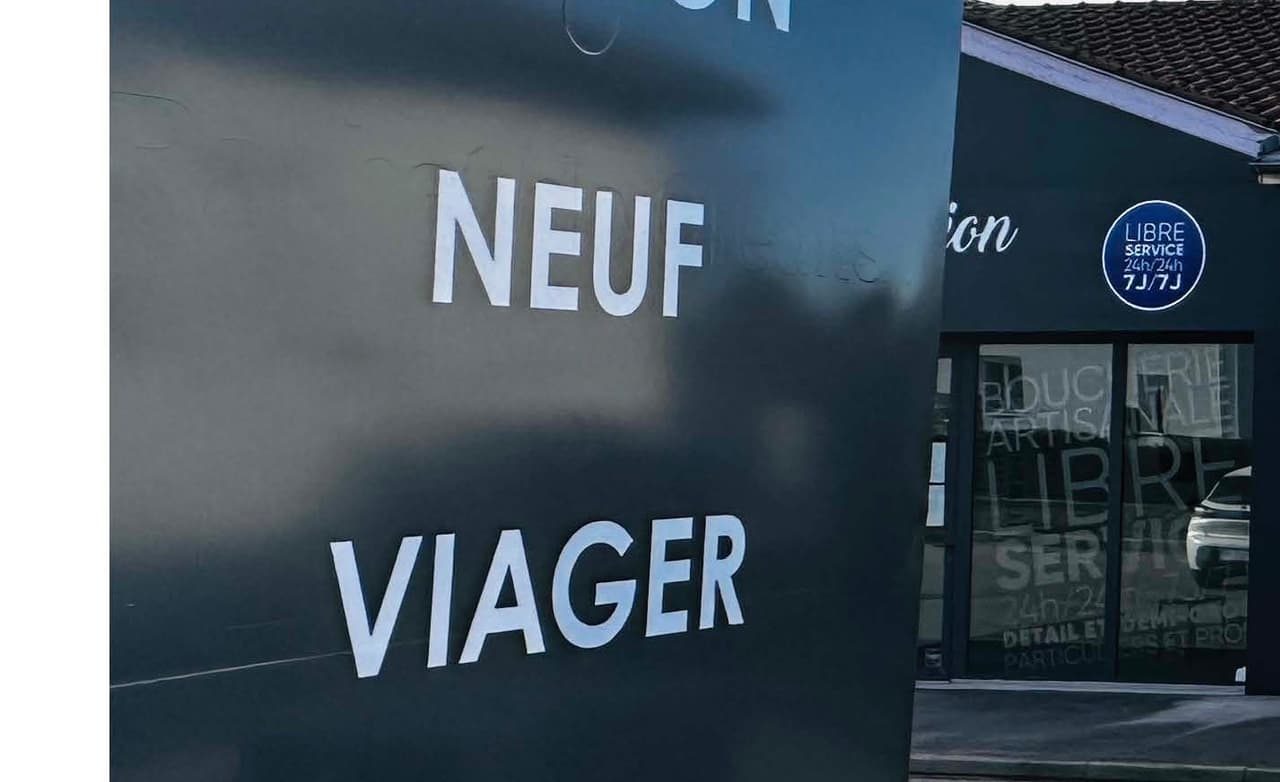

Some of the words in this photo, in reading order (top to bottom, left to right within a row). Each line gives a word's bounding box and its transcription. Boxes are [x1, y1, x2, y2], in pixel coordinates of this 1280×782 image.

[1125, 222, 1185, 242] LIBRE
[432, 169, 704, 318] NEUF
[1125, 243, 1184, 257] SERVICE
[1124, 258, 1183, 272] 24h/24h
[1123, 273, 1181, 291] 7J/7J
[330, 514, 746, 679] VIAGER
